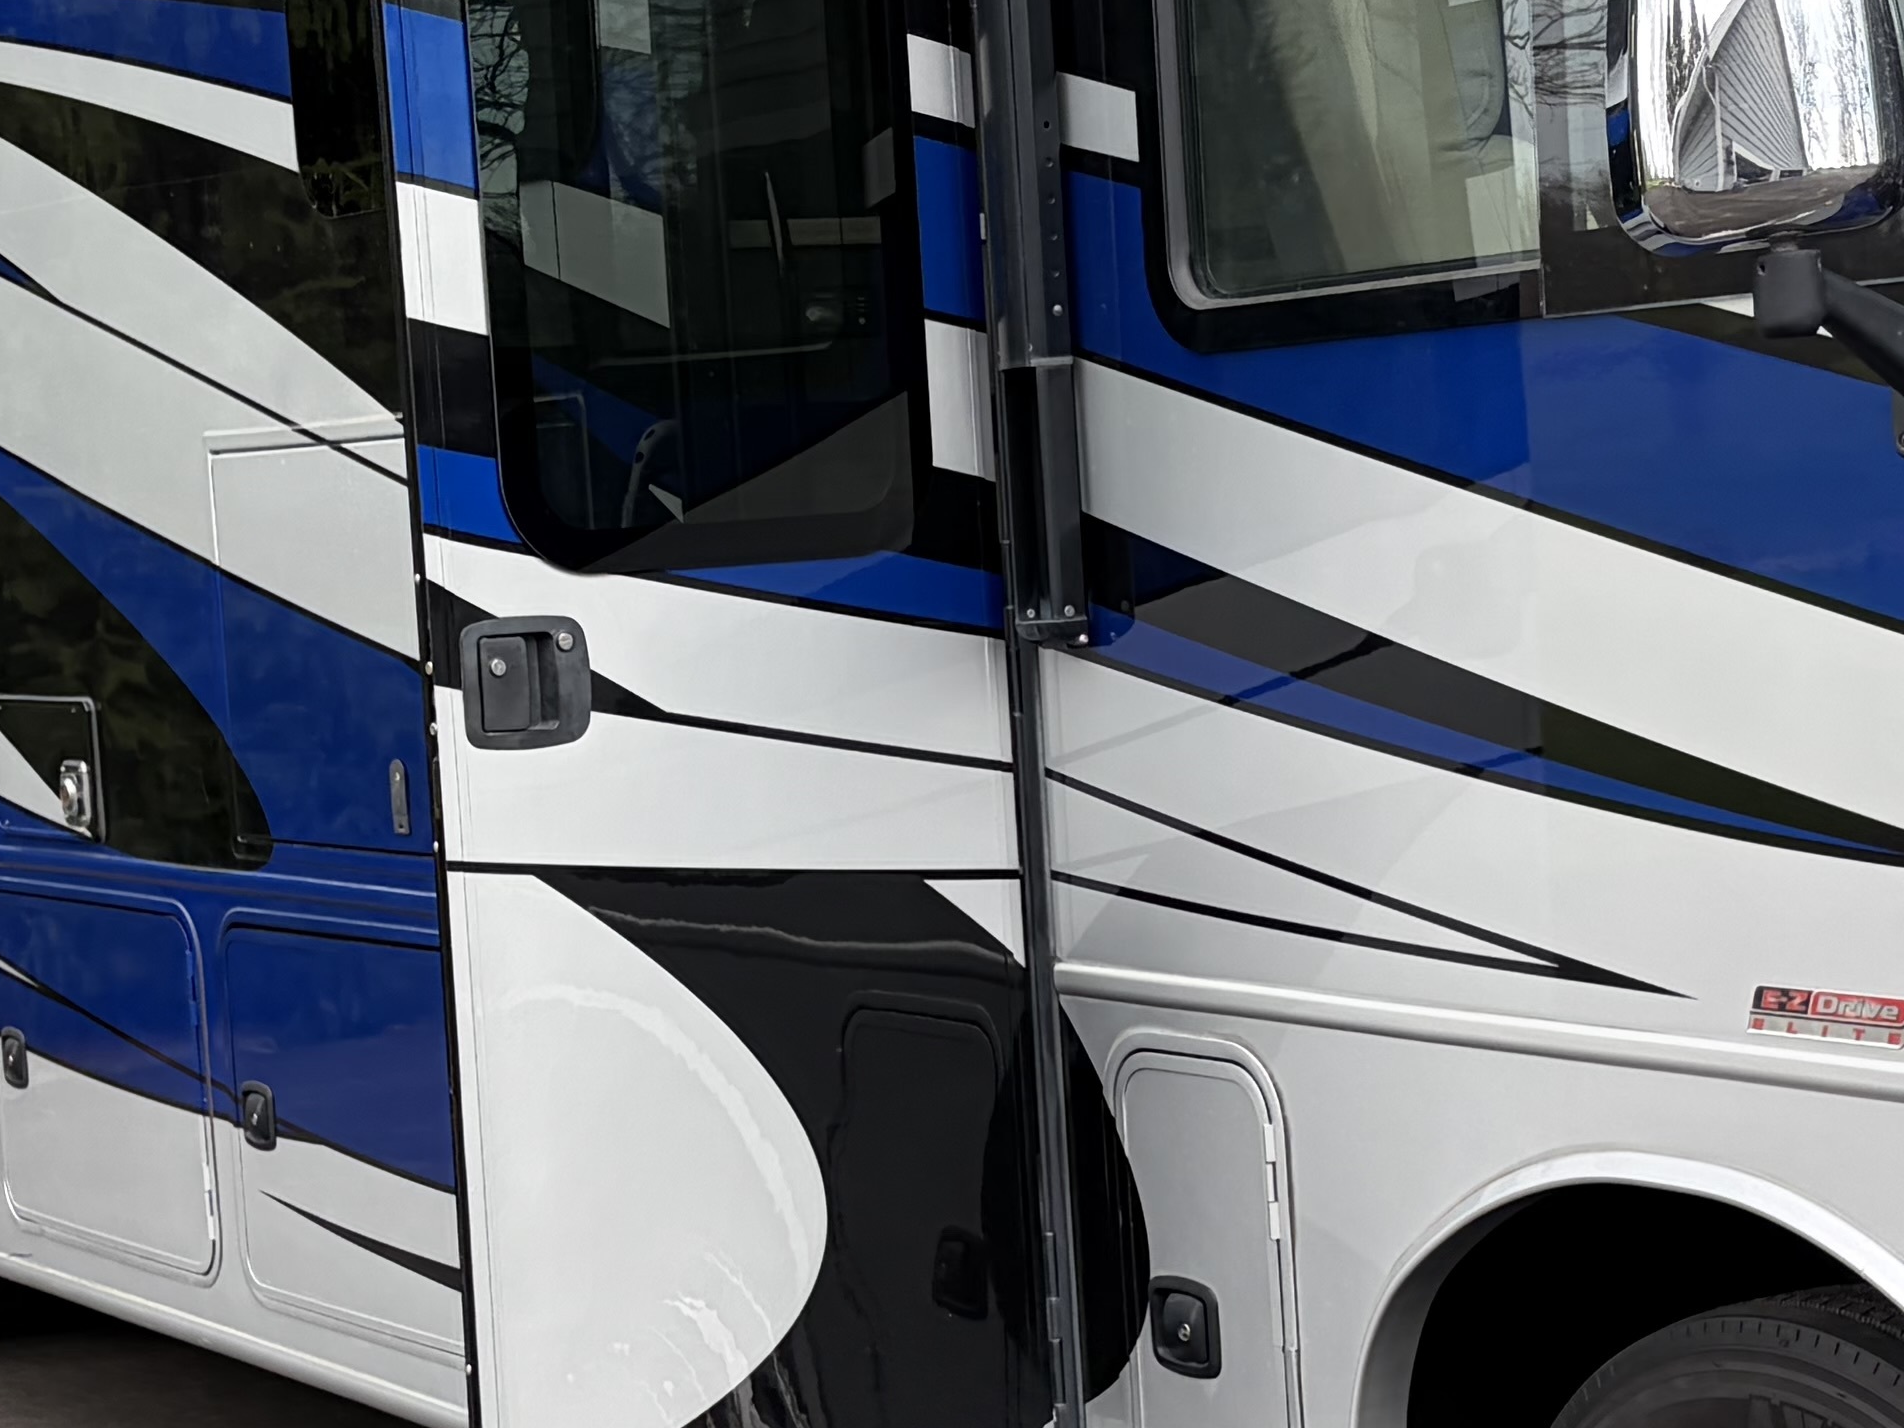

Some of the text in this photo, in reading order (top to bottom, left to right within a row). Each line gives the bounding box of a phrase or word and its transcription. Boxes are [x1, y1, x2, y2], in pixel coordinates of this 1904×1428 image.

[1761, 990, 1899, 1021] E-Z Drive
[1752, 1018, 1901, 1045] ELITE
